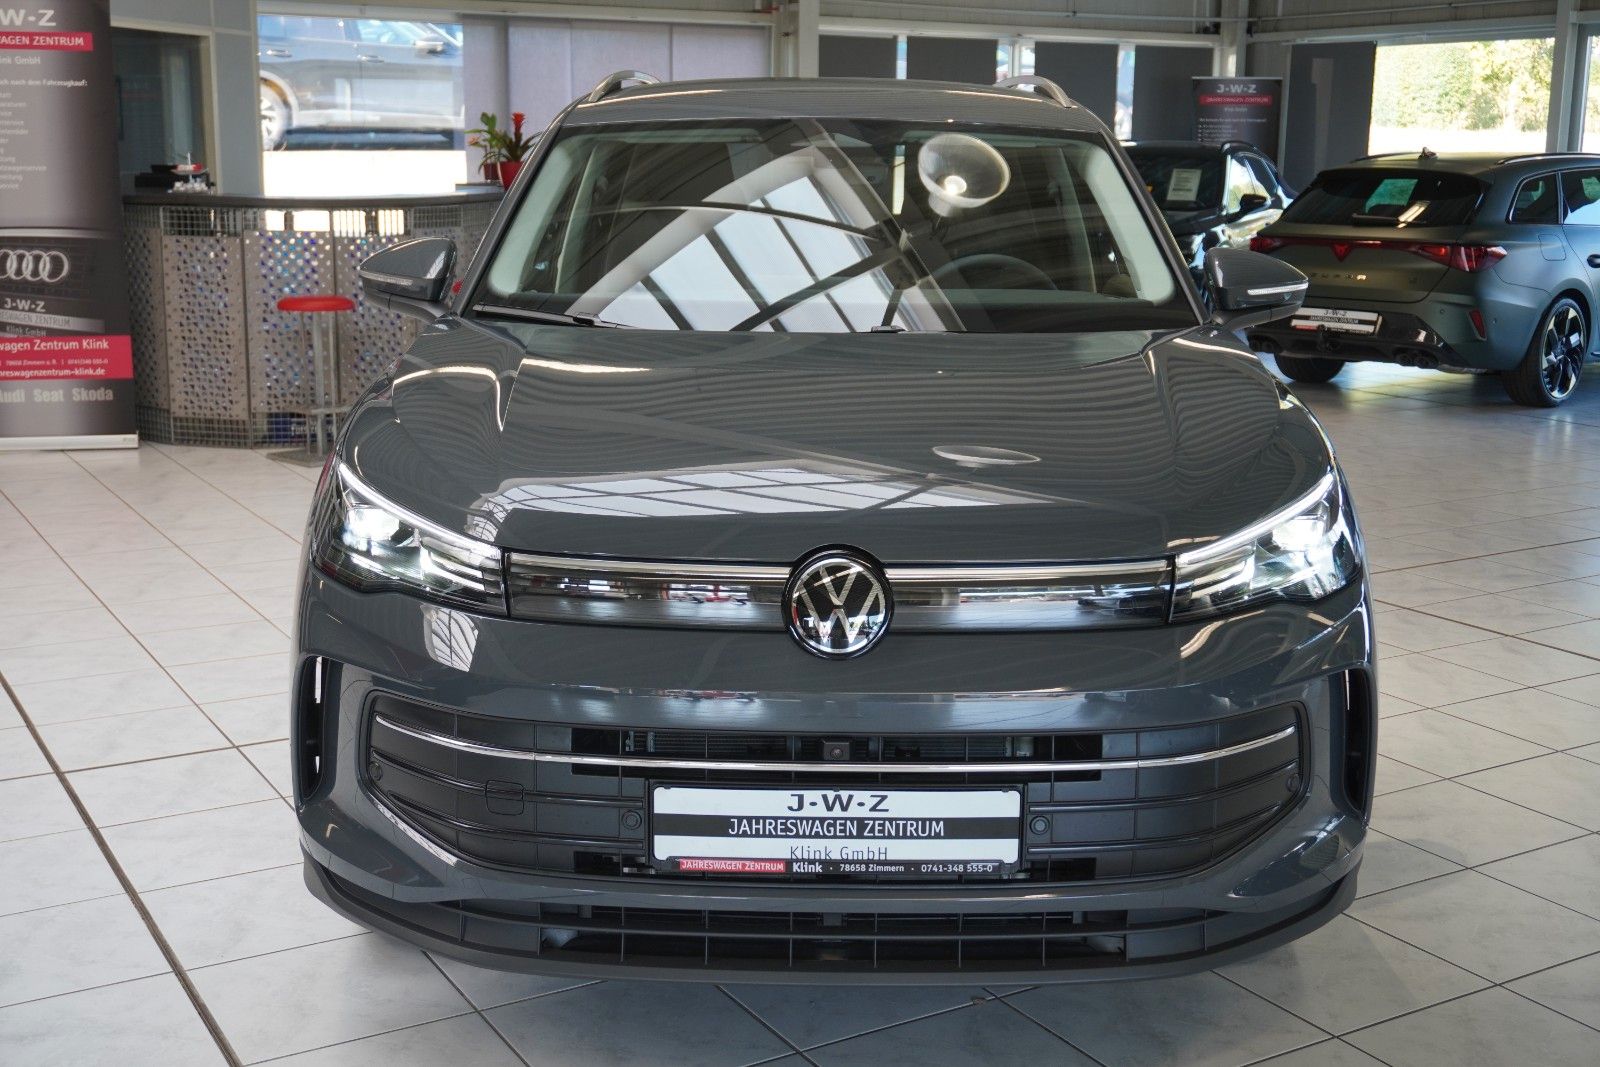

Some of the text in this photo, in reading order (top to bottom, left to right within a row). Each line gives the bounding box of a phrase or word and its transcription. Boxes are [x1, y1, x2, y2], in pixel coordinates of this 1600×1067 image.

[0, 35, 84, 46] AGEN ZENTRUM
[15, 56, 41, 65] GmbH
[35, 315, 71, 328] ZENTRUM
[33, 339, 79, 351] Zentrum
[82, 338, 110, 350] Klink
[33, 388, 64, 402] Seat
[72, 386, 114, 401] Skoda
[729, 818, 945, 837] JAHRESWAGEN ZENTRUM
[790, 845, 888, 861] Klink GmbH
[681, 859, 993, 873] JAHRESWAGEN ZENTRUM Klink 78658 Zimmern 0741-348 555-0
